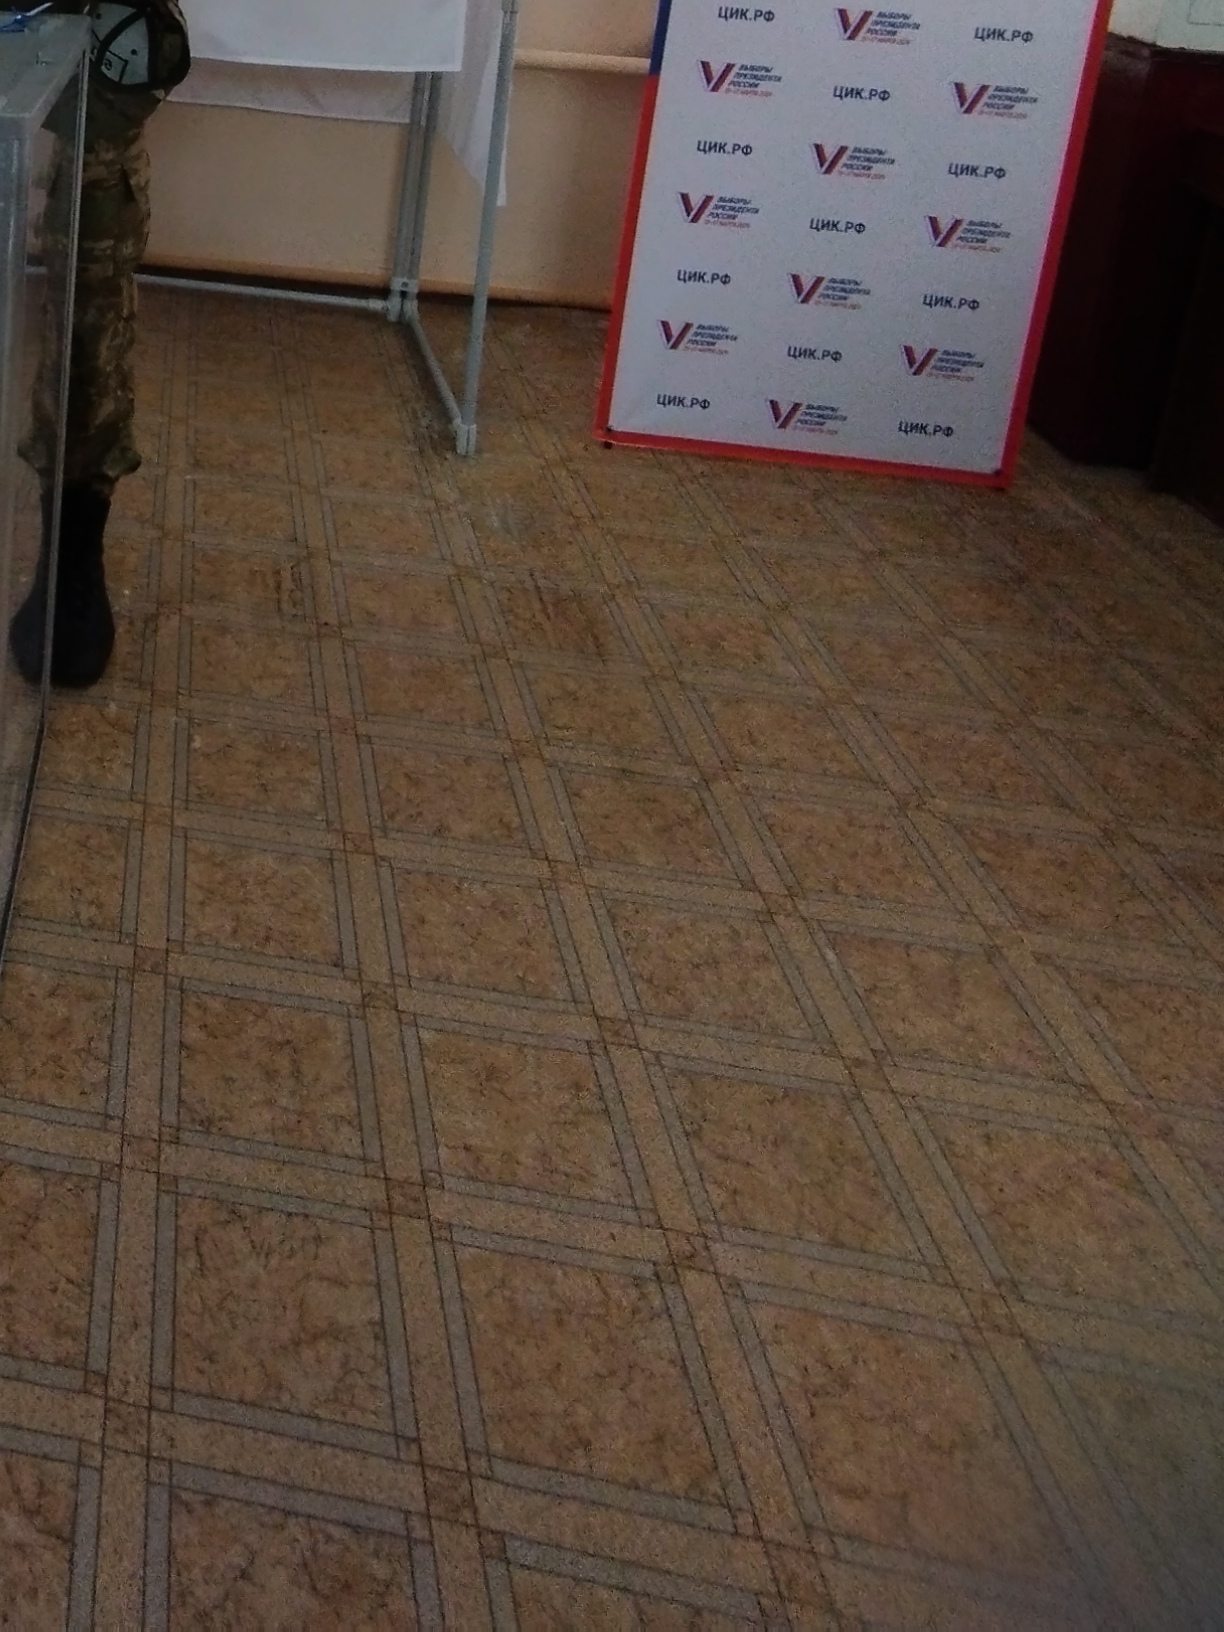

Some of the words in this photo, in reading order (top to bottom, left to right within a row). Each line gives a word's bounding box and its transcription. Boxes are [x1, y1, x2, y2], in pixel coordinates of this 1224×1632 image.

[717, 6, 775, 23] ЦИК.РФ
[974, 26, 1034, 44] ЦИК.РФ
[832, 85, 891, 102] ЦИК.РФ
[696, 140, 753, 157] ЦИК.РФ
[947, 162, 1007, 180] ЦИК.РФ
[809, 218, 866, 235] ЦИК.РФ
[676, 269, 731, 286] ЦИК.РФ
[922, 294, 980, 311] ЦИК.РФ
[787, 345, 843, 363] ЦИК.РФ
[656, 393, 711, 410] ЦИК.РФ
[897, 420, 954, 438] ЦИК.РФ
